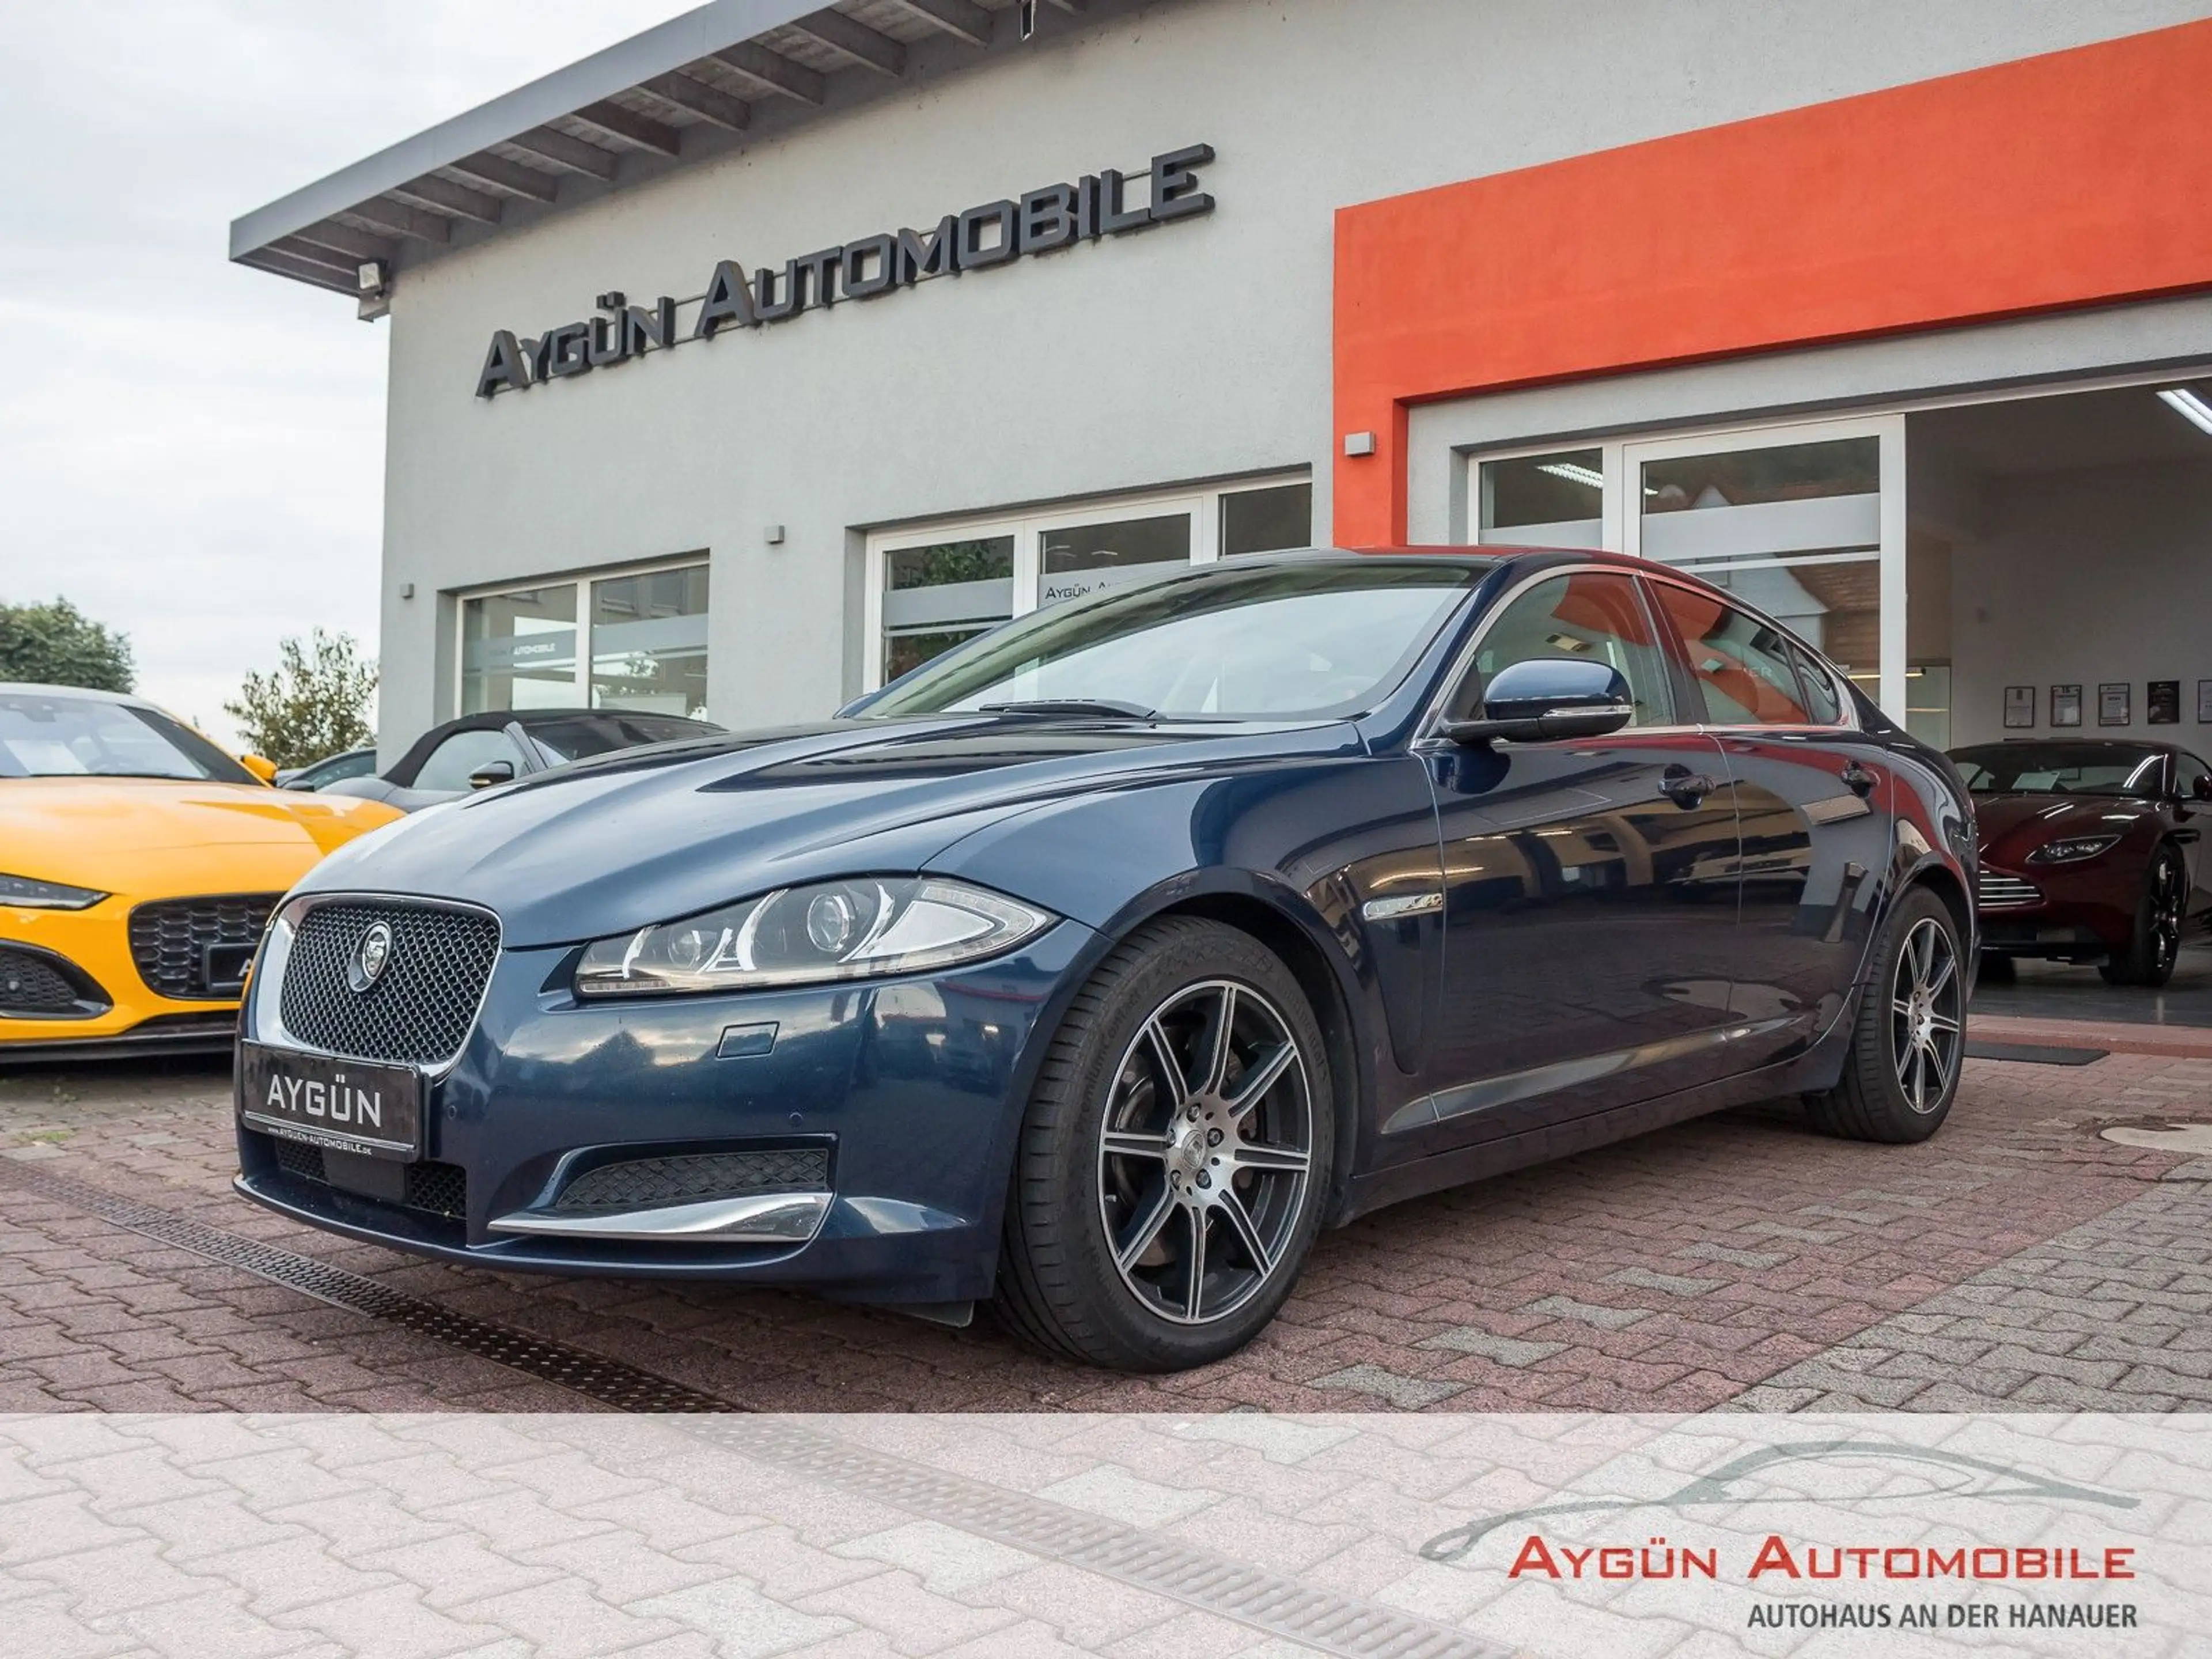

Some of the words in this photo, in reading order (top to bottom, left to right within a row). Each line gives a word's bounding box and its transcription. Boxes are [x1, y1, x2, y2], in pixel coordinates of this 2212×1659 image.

[476, 291, 676, 397] AYGÜN
[694, 143, 1216, 340] AUTOMOBILE
[267, 1074, 381, 1128] AYGÜN
